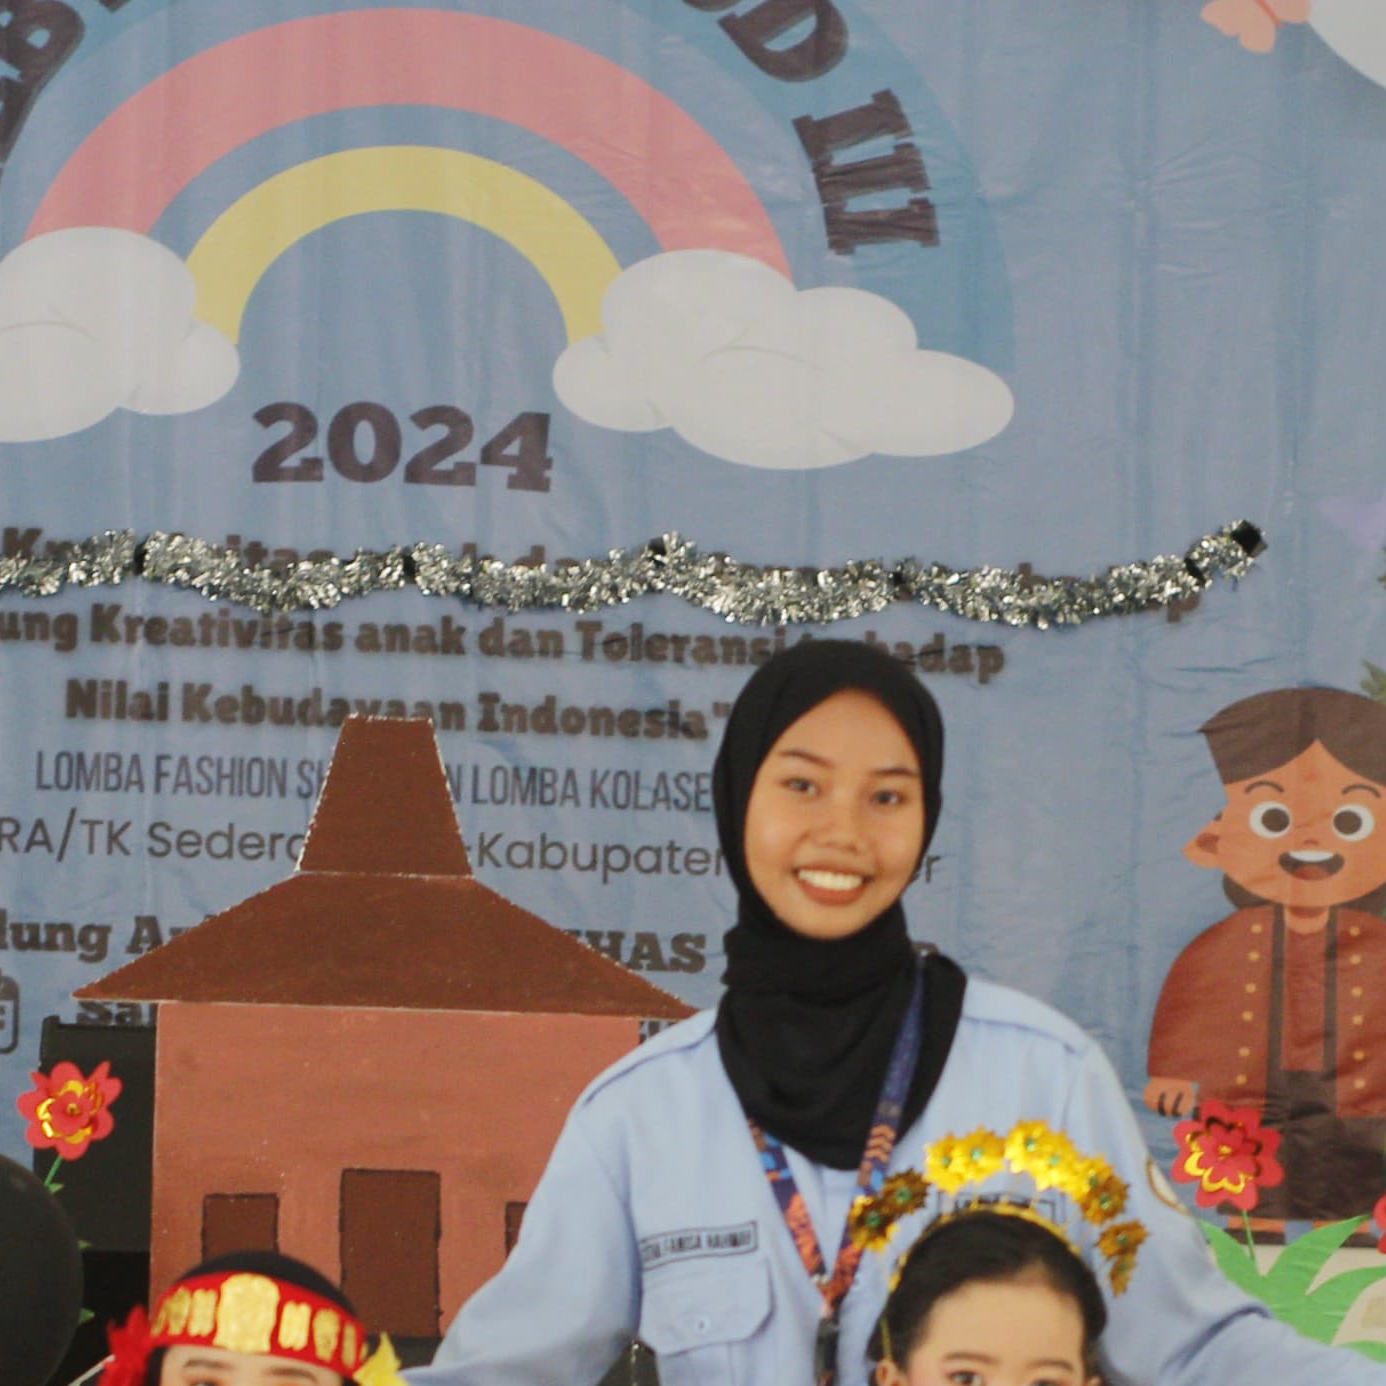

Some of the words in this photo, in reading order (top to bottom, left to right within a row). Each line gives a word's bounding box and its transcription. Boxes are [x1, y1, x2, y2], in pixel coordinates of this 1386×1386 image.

[251, 401, 553, 493] 2024
[90, 603, 344, 652] Kreativitas
[354, 614, 466, 656] anak
[478, 618, 564, 659] dan
[575, 620, 786, 666] Toleransi
[64, 678, 169, 722] Nilai
[36, 750, 145, 794] LOMBA
[154, 755, 287, 798] FASHION
[472, 765, 580, 808] LOMBA
[590, 769, 713, 813] KOLASE
